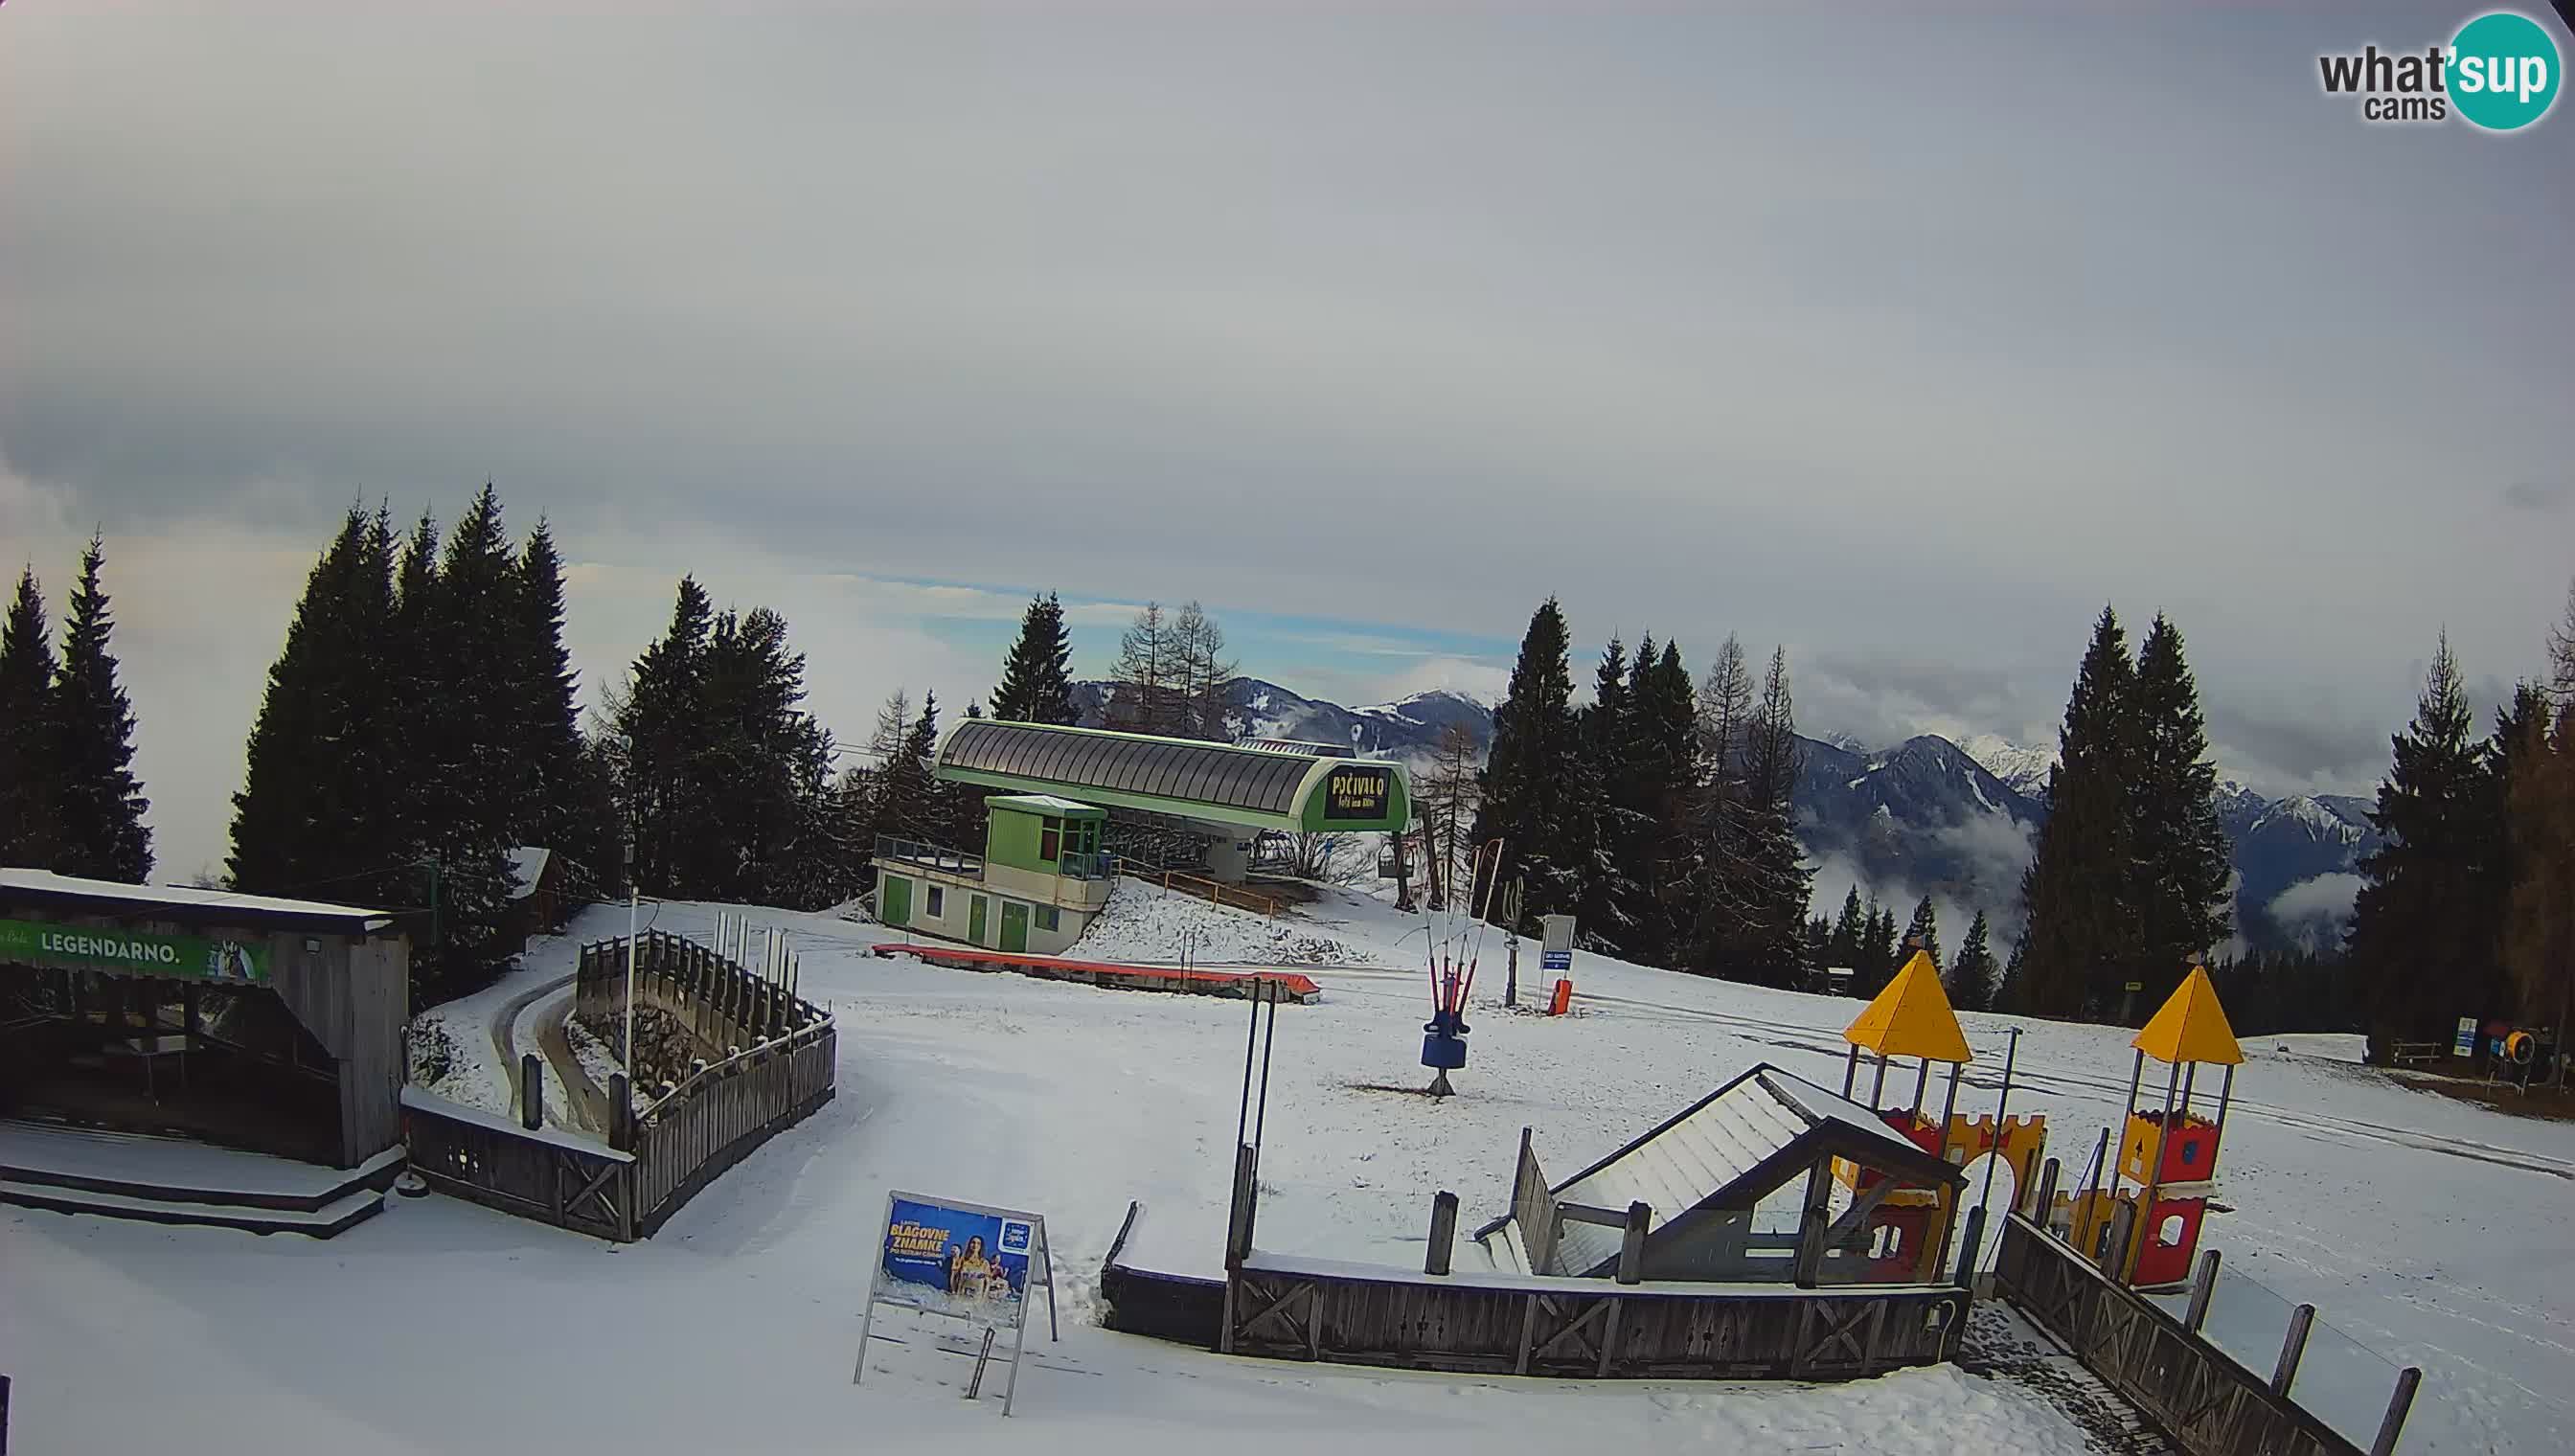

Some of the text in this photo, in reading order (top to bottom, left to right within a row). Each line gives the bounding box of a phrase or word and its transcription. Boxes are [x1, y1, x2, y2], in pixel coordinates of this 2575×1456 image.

[41, 932, 181, 964] LEGENDARNO.
[890, 1223, 950, 1241] BLAGOVNE
[893, 1236, 944, 1253] ZNAMKE
